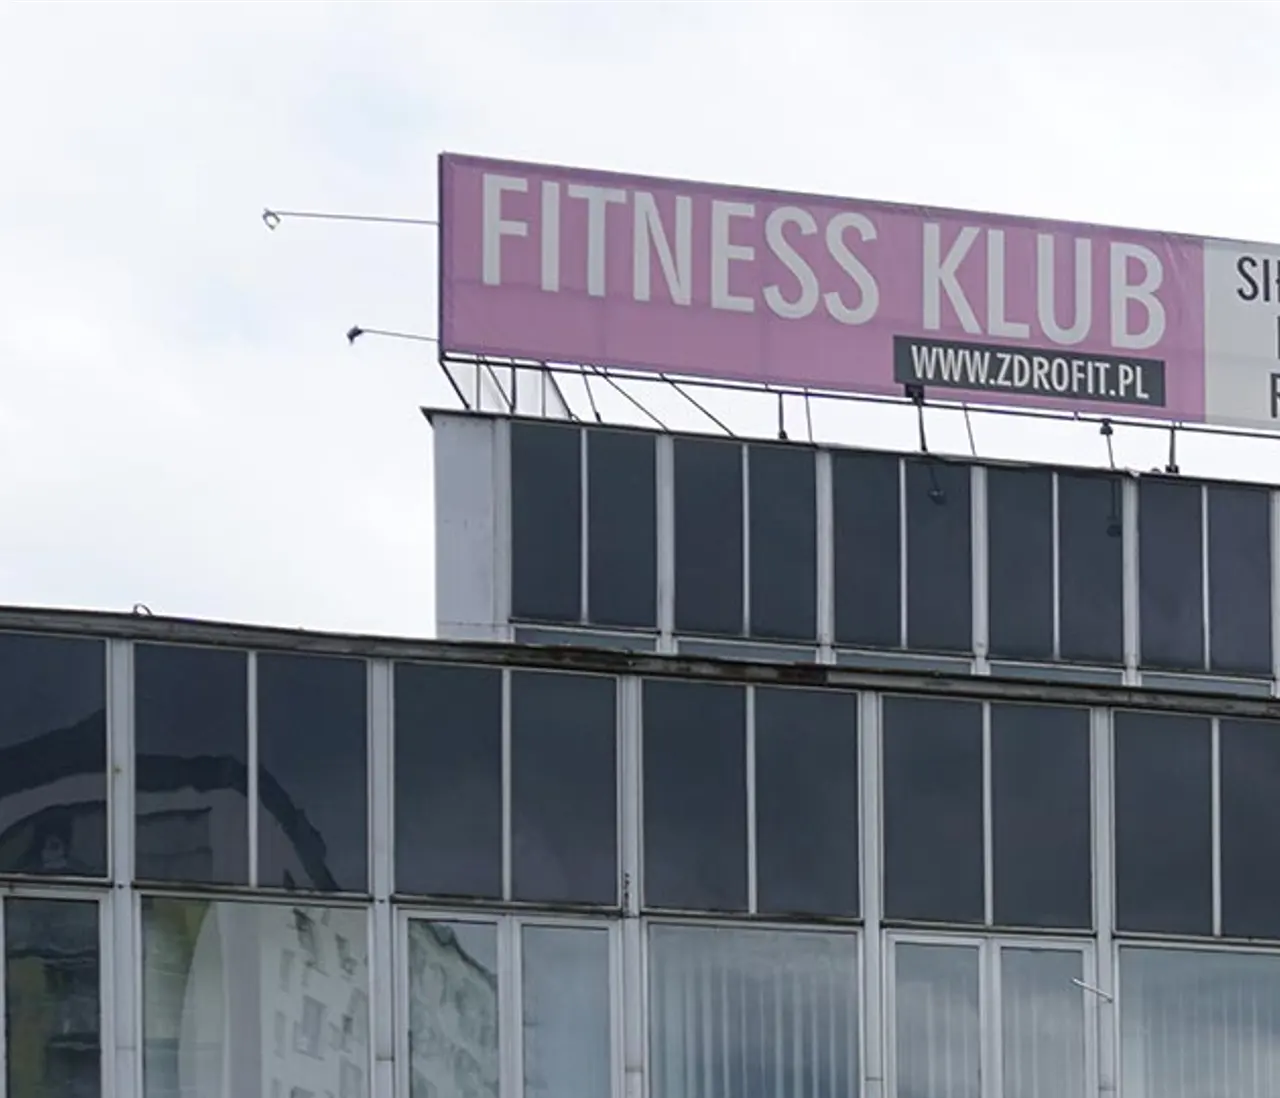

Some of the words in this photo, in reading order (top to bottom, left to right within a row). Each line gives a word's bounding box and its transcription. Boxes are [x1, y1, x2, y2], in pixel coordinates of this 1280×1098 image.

[482, 172, 880, 326] FITNESS
[922, 222, 1166, 350] KLUB
[911, 344, 1150, 400] WWW.ZDROFIT.PL
